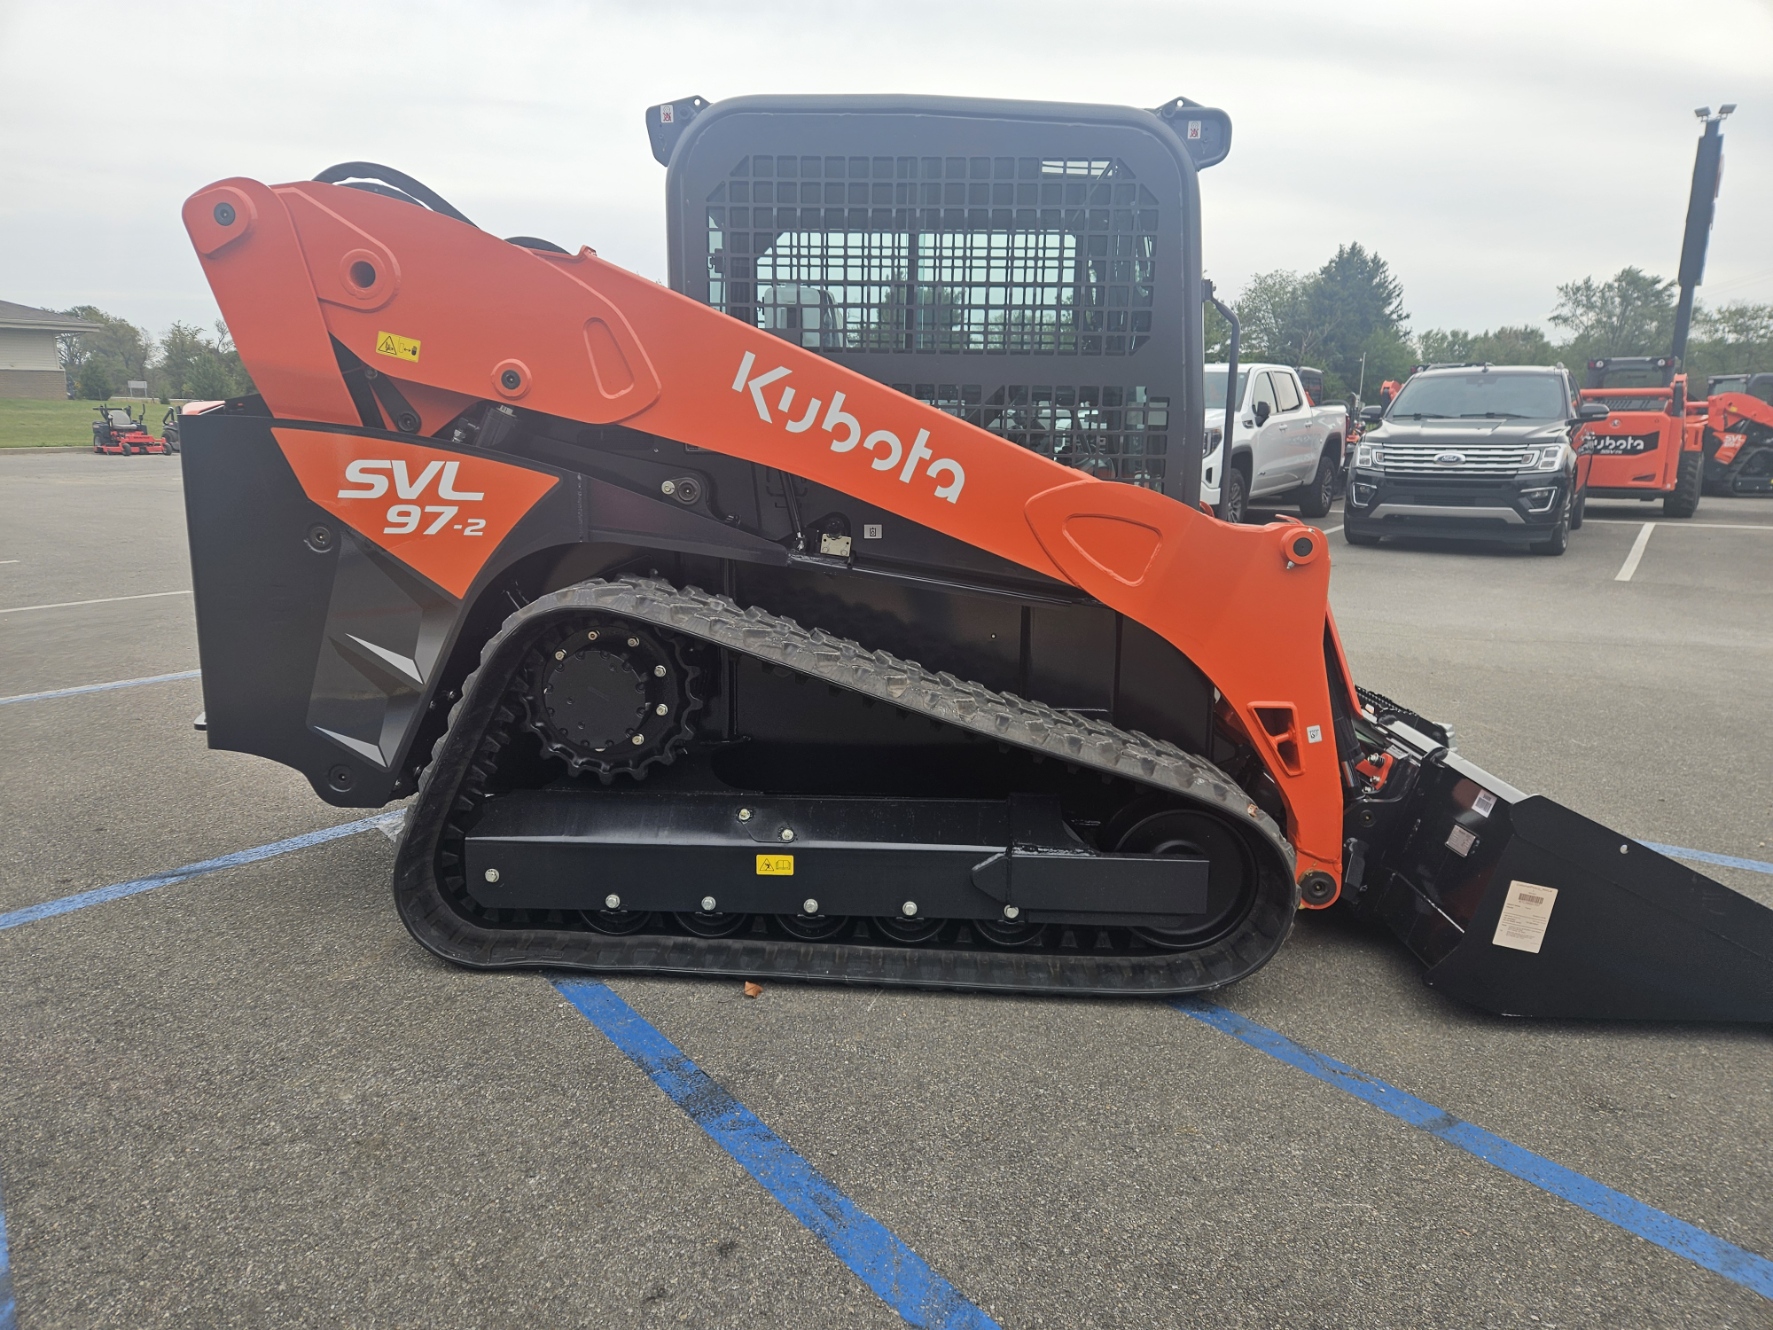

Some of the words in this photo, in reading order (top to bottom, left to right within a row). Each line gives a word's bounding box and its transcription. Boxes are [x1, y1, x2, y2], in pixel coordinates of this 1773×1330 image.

[731, 350, 966, 504] Kubota
[1588, 435, 1645, 450] ubota
[337, 459, 485, 500] SVL
[383, 505, 486, 536] 97-2
